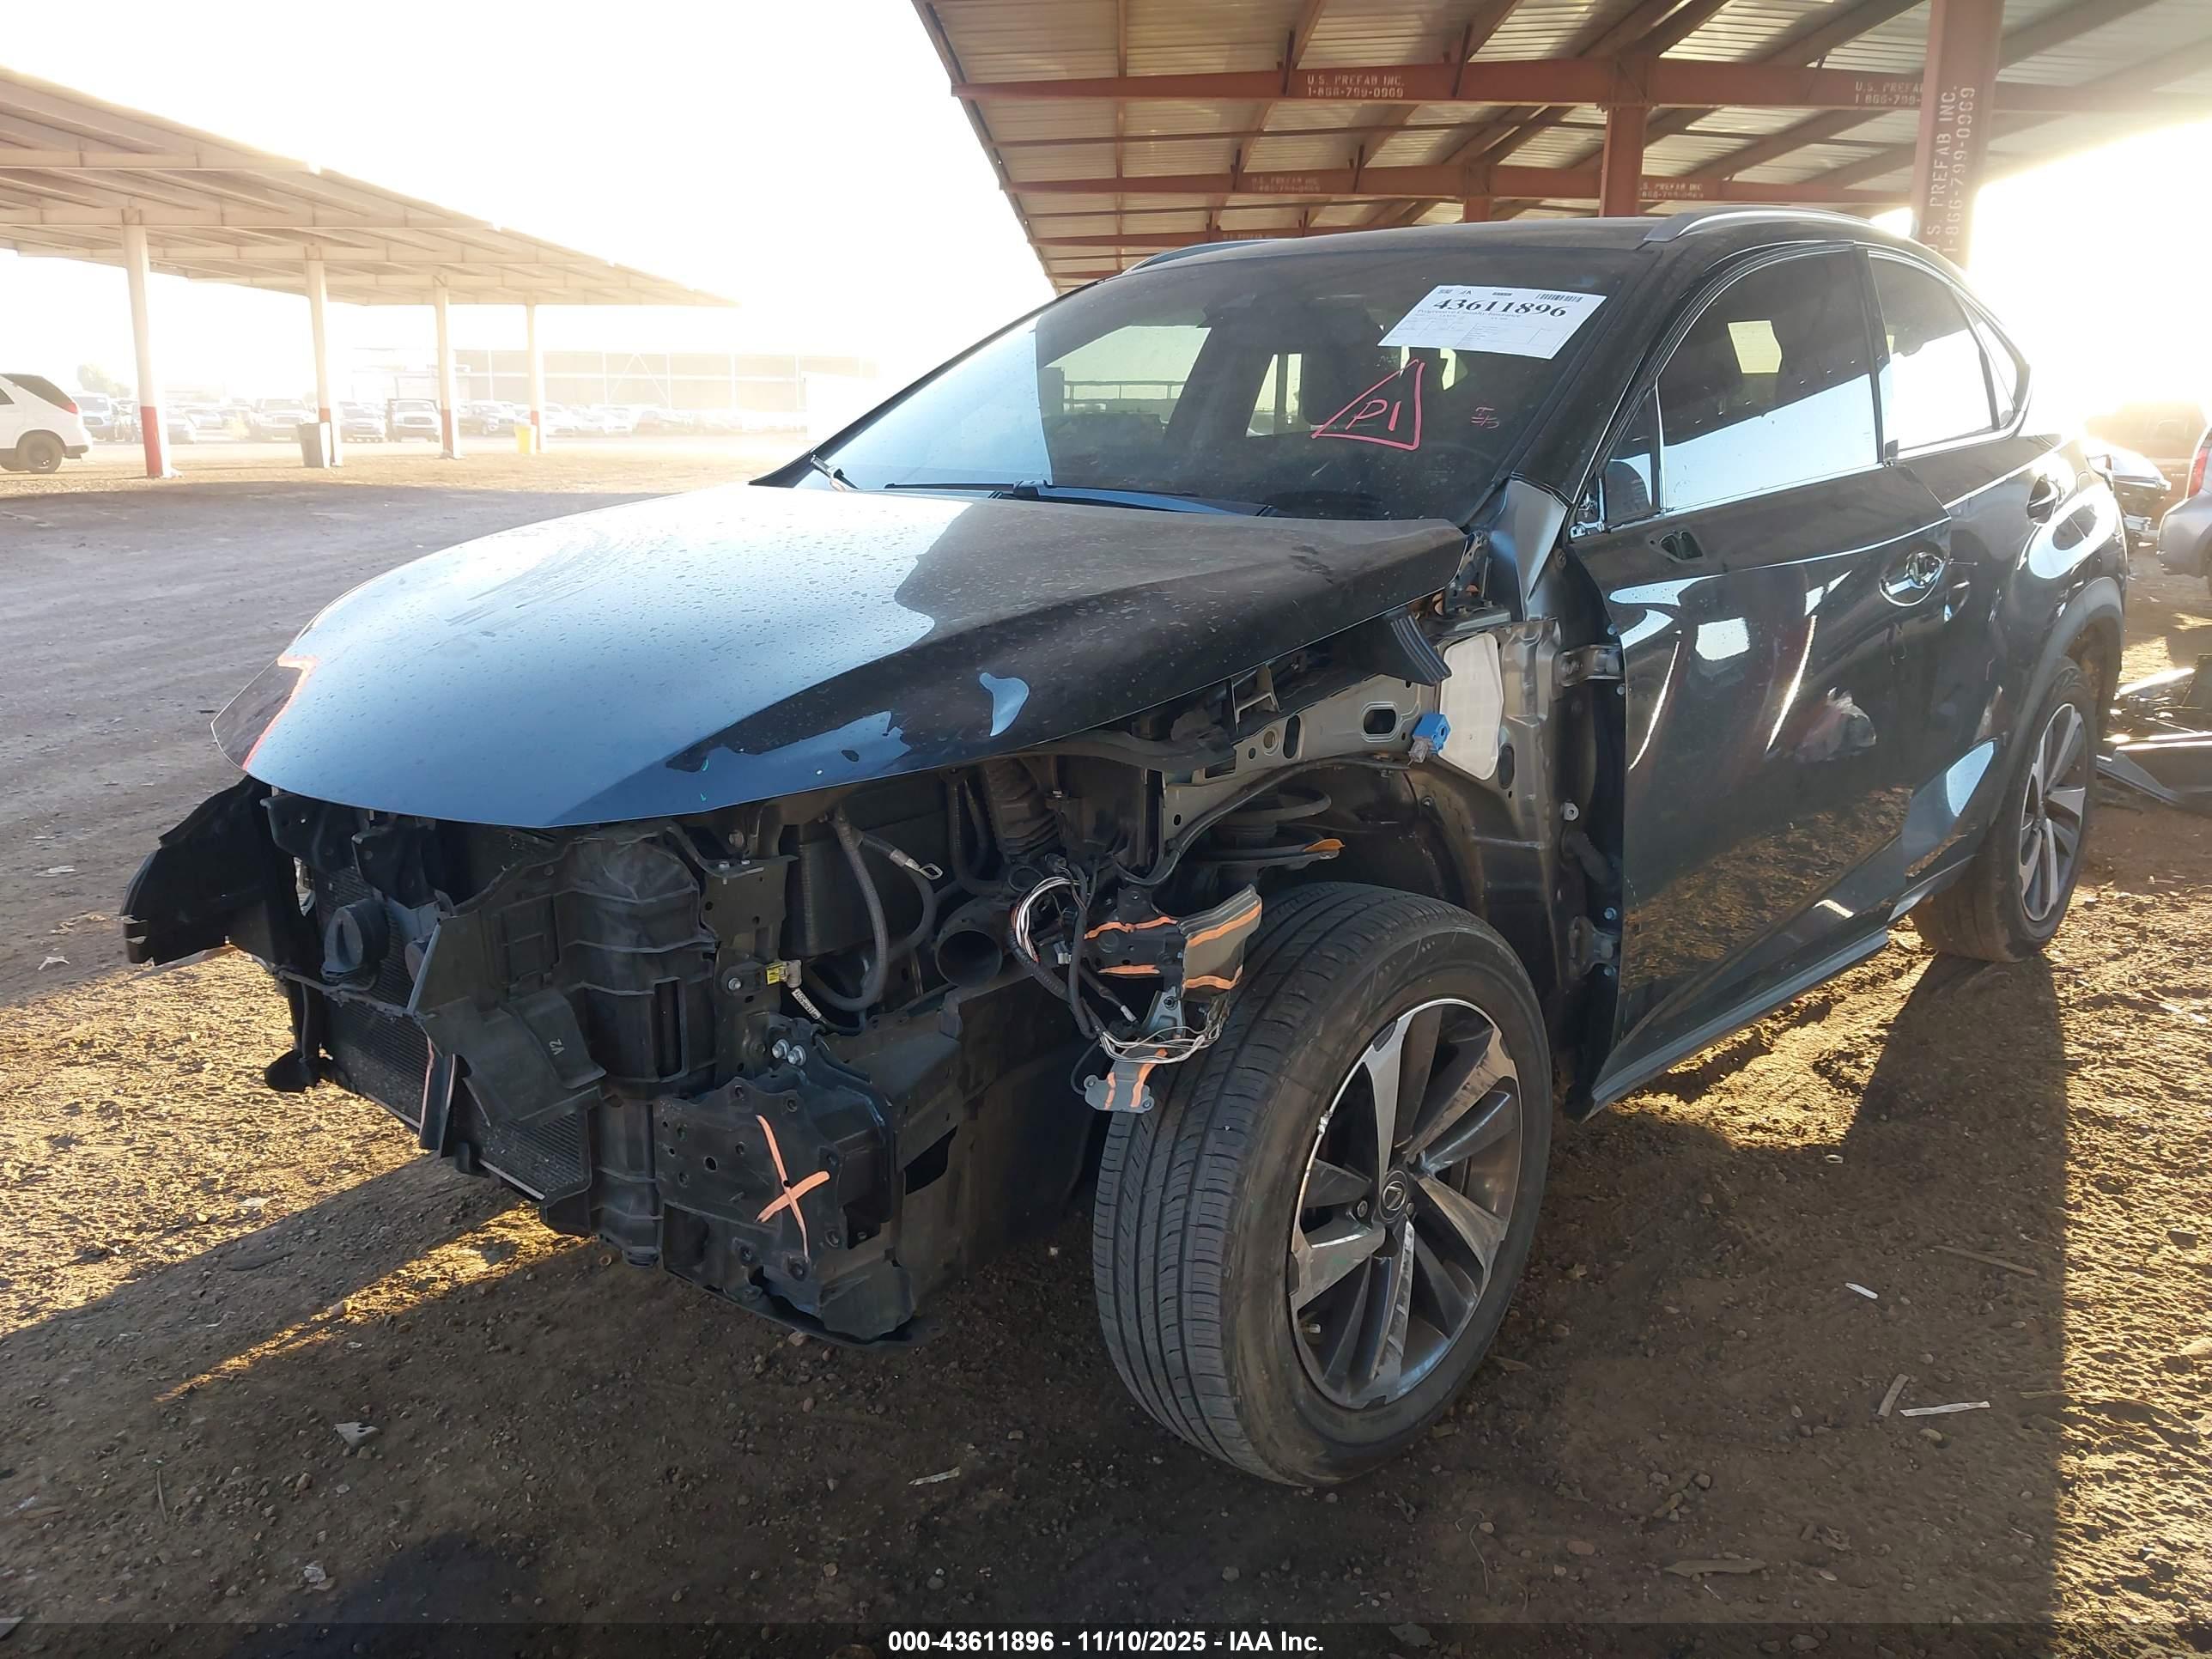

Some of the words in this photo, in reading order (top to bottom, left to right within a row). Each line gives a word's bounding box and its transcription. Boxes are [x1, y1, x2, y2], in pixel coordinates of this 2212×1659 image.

[1334, 74, 1378, 86] PREFAB
[1938, 86, 1958, 122] INC.
[1929, 132, 1952, 207] PREFAB
[1942, 87, 1975, 252] 1-866-799-0969
[1433, 298, 1571, 318] 43611896
